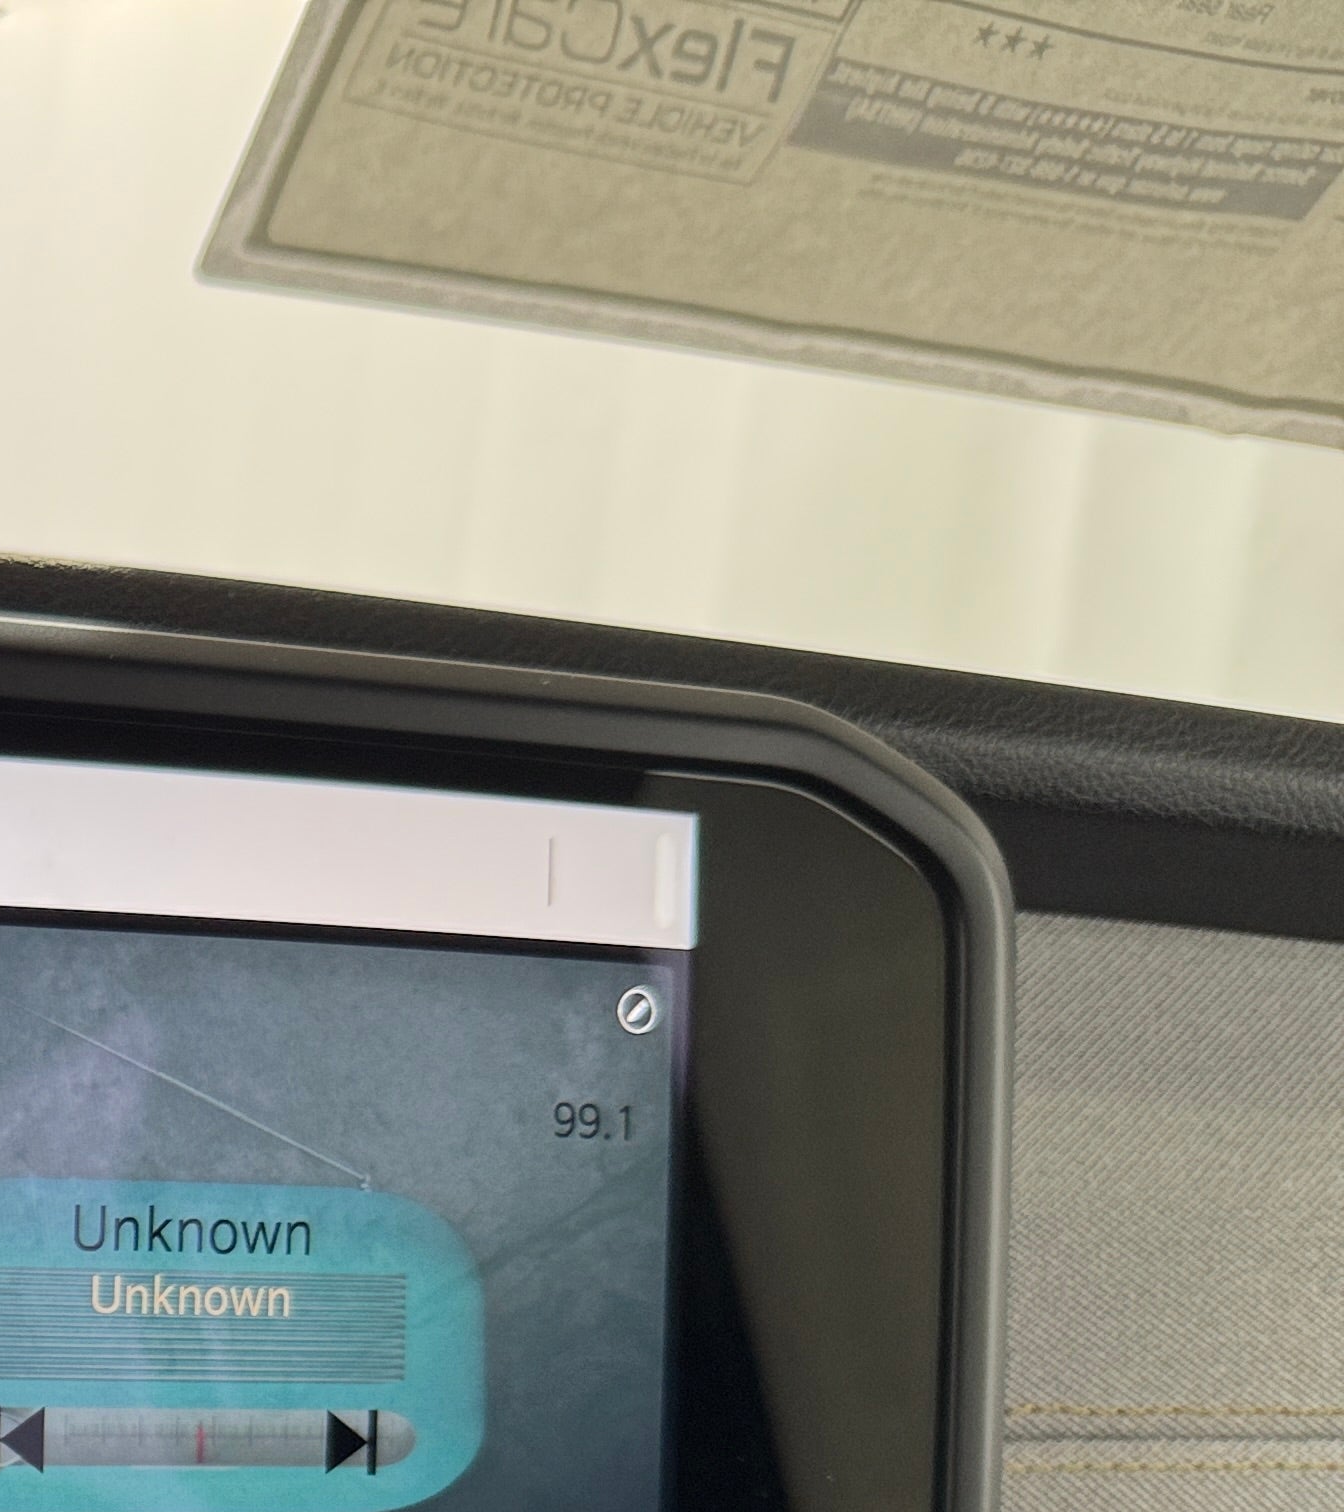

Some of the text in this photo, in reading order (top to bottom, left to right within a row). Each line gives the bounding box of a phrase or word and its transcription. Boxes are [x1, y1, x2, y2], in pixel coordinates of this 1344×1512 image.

[552, 1101, 633, 1142] 99.1
[72, 1203, 312, 1256] Unknown
[91, 1274, 291, 1318] Unknown
